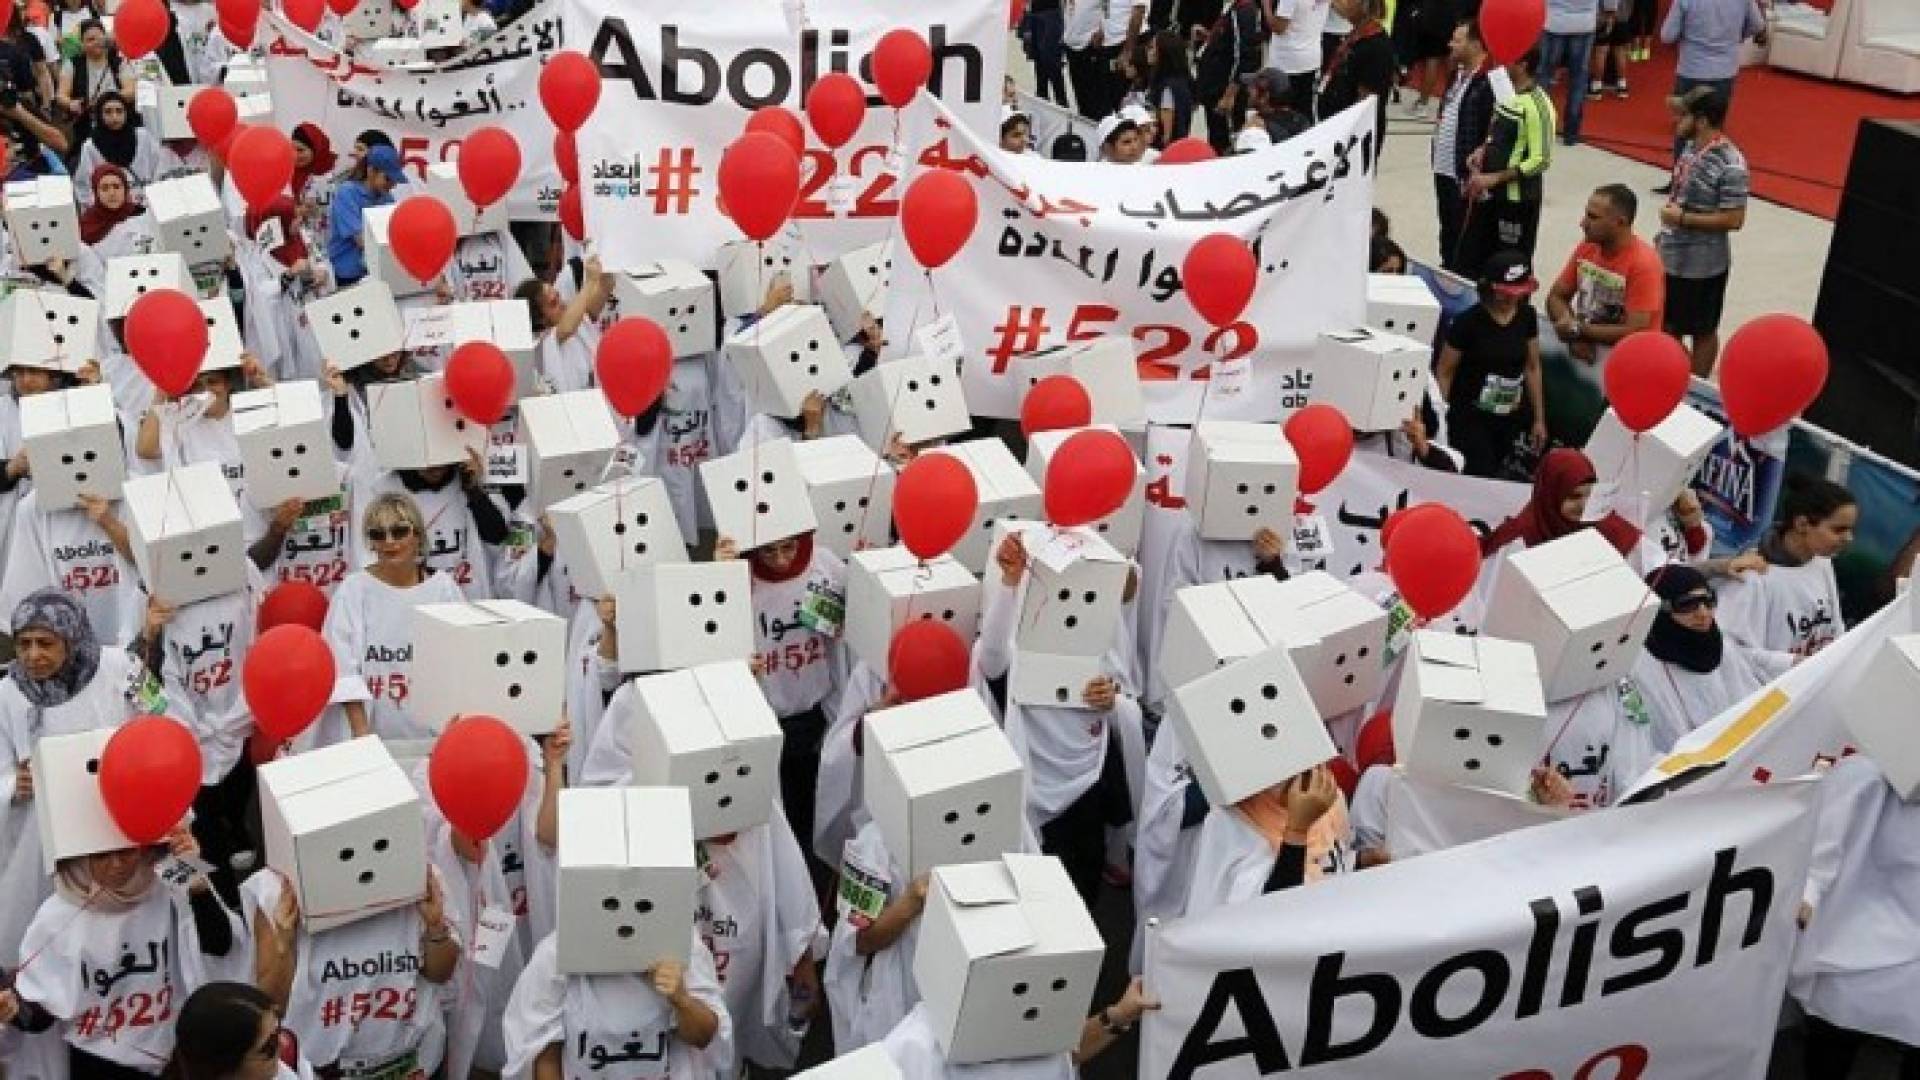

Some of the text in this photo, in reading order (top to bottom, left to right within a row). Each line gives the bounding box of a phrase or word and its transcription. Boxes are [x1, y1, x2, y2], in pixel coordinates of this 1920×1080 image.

[645, 147, 899, 218] #22
[365, 642, 414, 663] Abol
[321, 949, 418, 985] Abolish
[1167, 847, 1774, 1080] Abolish
